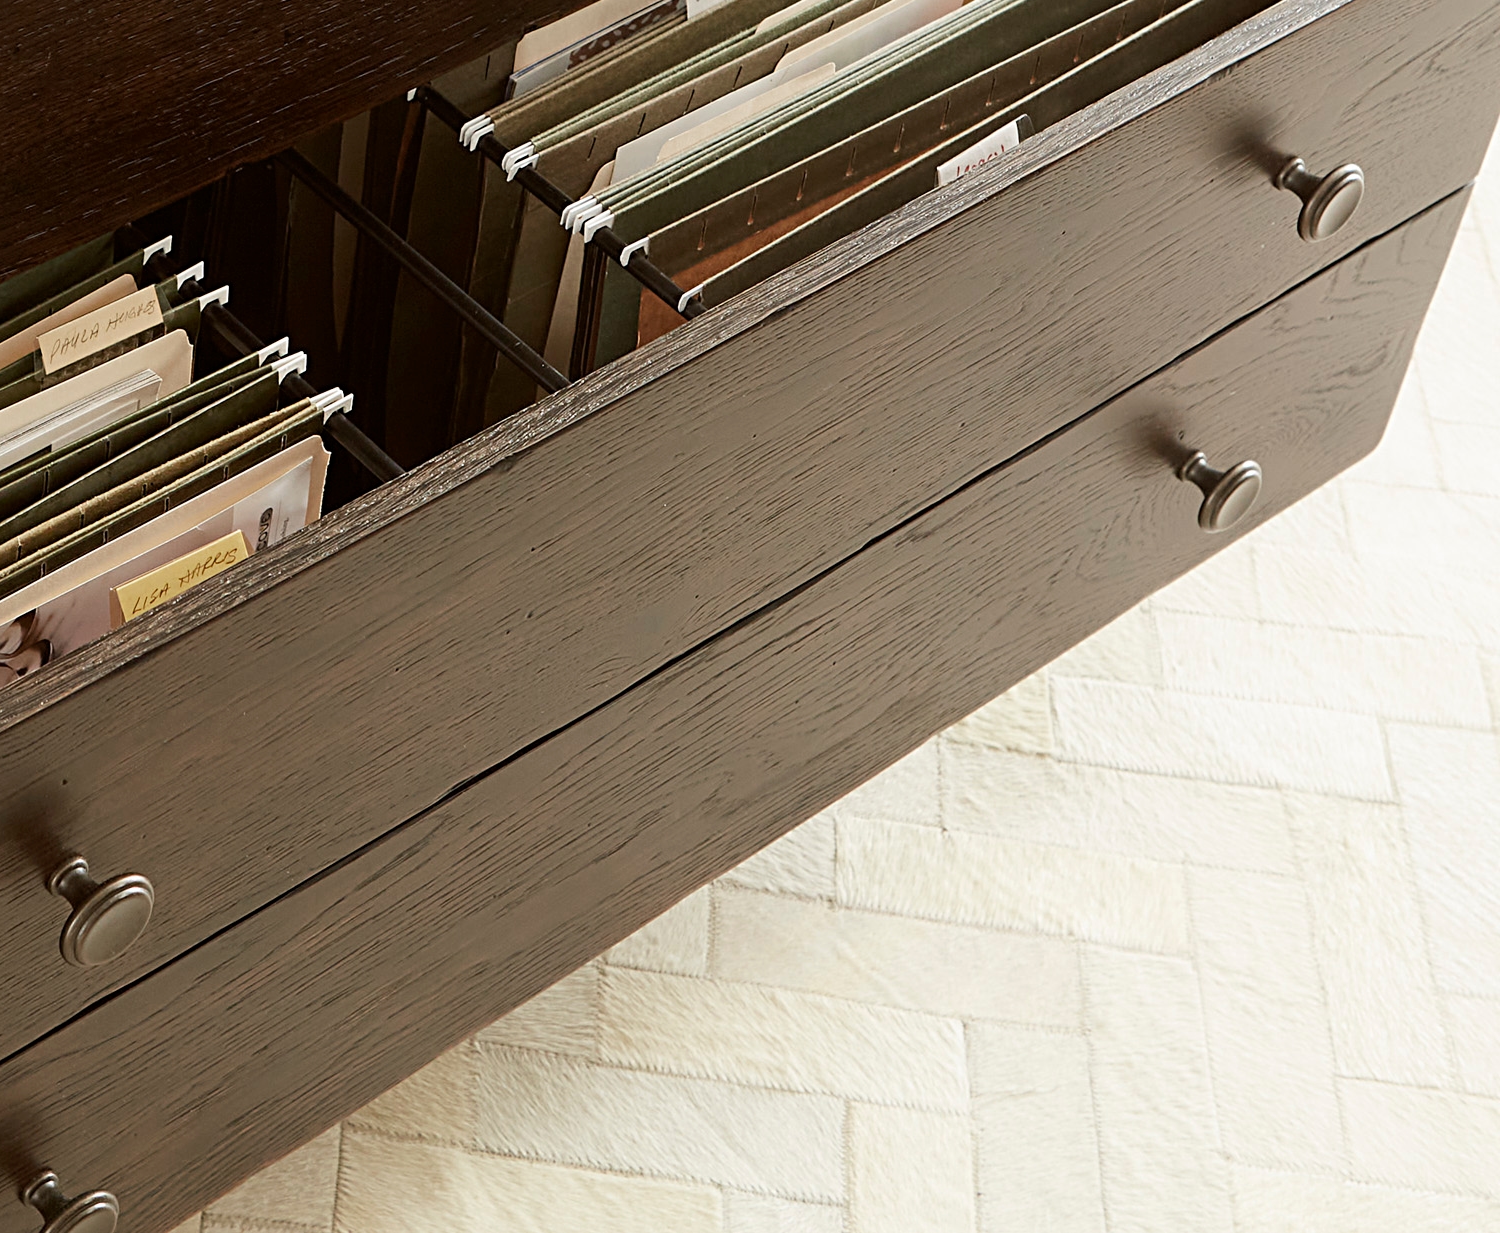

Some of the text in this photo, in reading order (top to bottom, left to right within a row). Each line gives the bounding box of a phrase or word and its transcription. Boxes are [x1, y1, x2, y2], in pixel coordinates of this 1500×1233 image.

[49, 322, 100, 365] PAULA
[132, 548, 238, 615] LISA HARRIS
